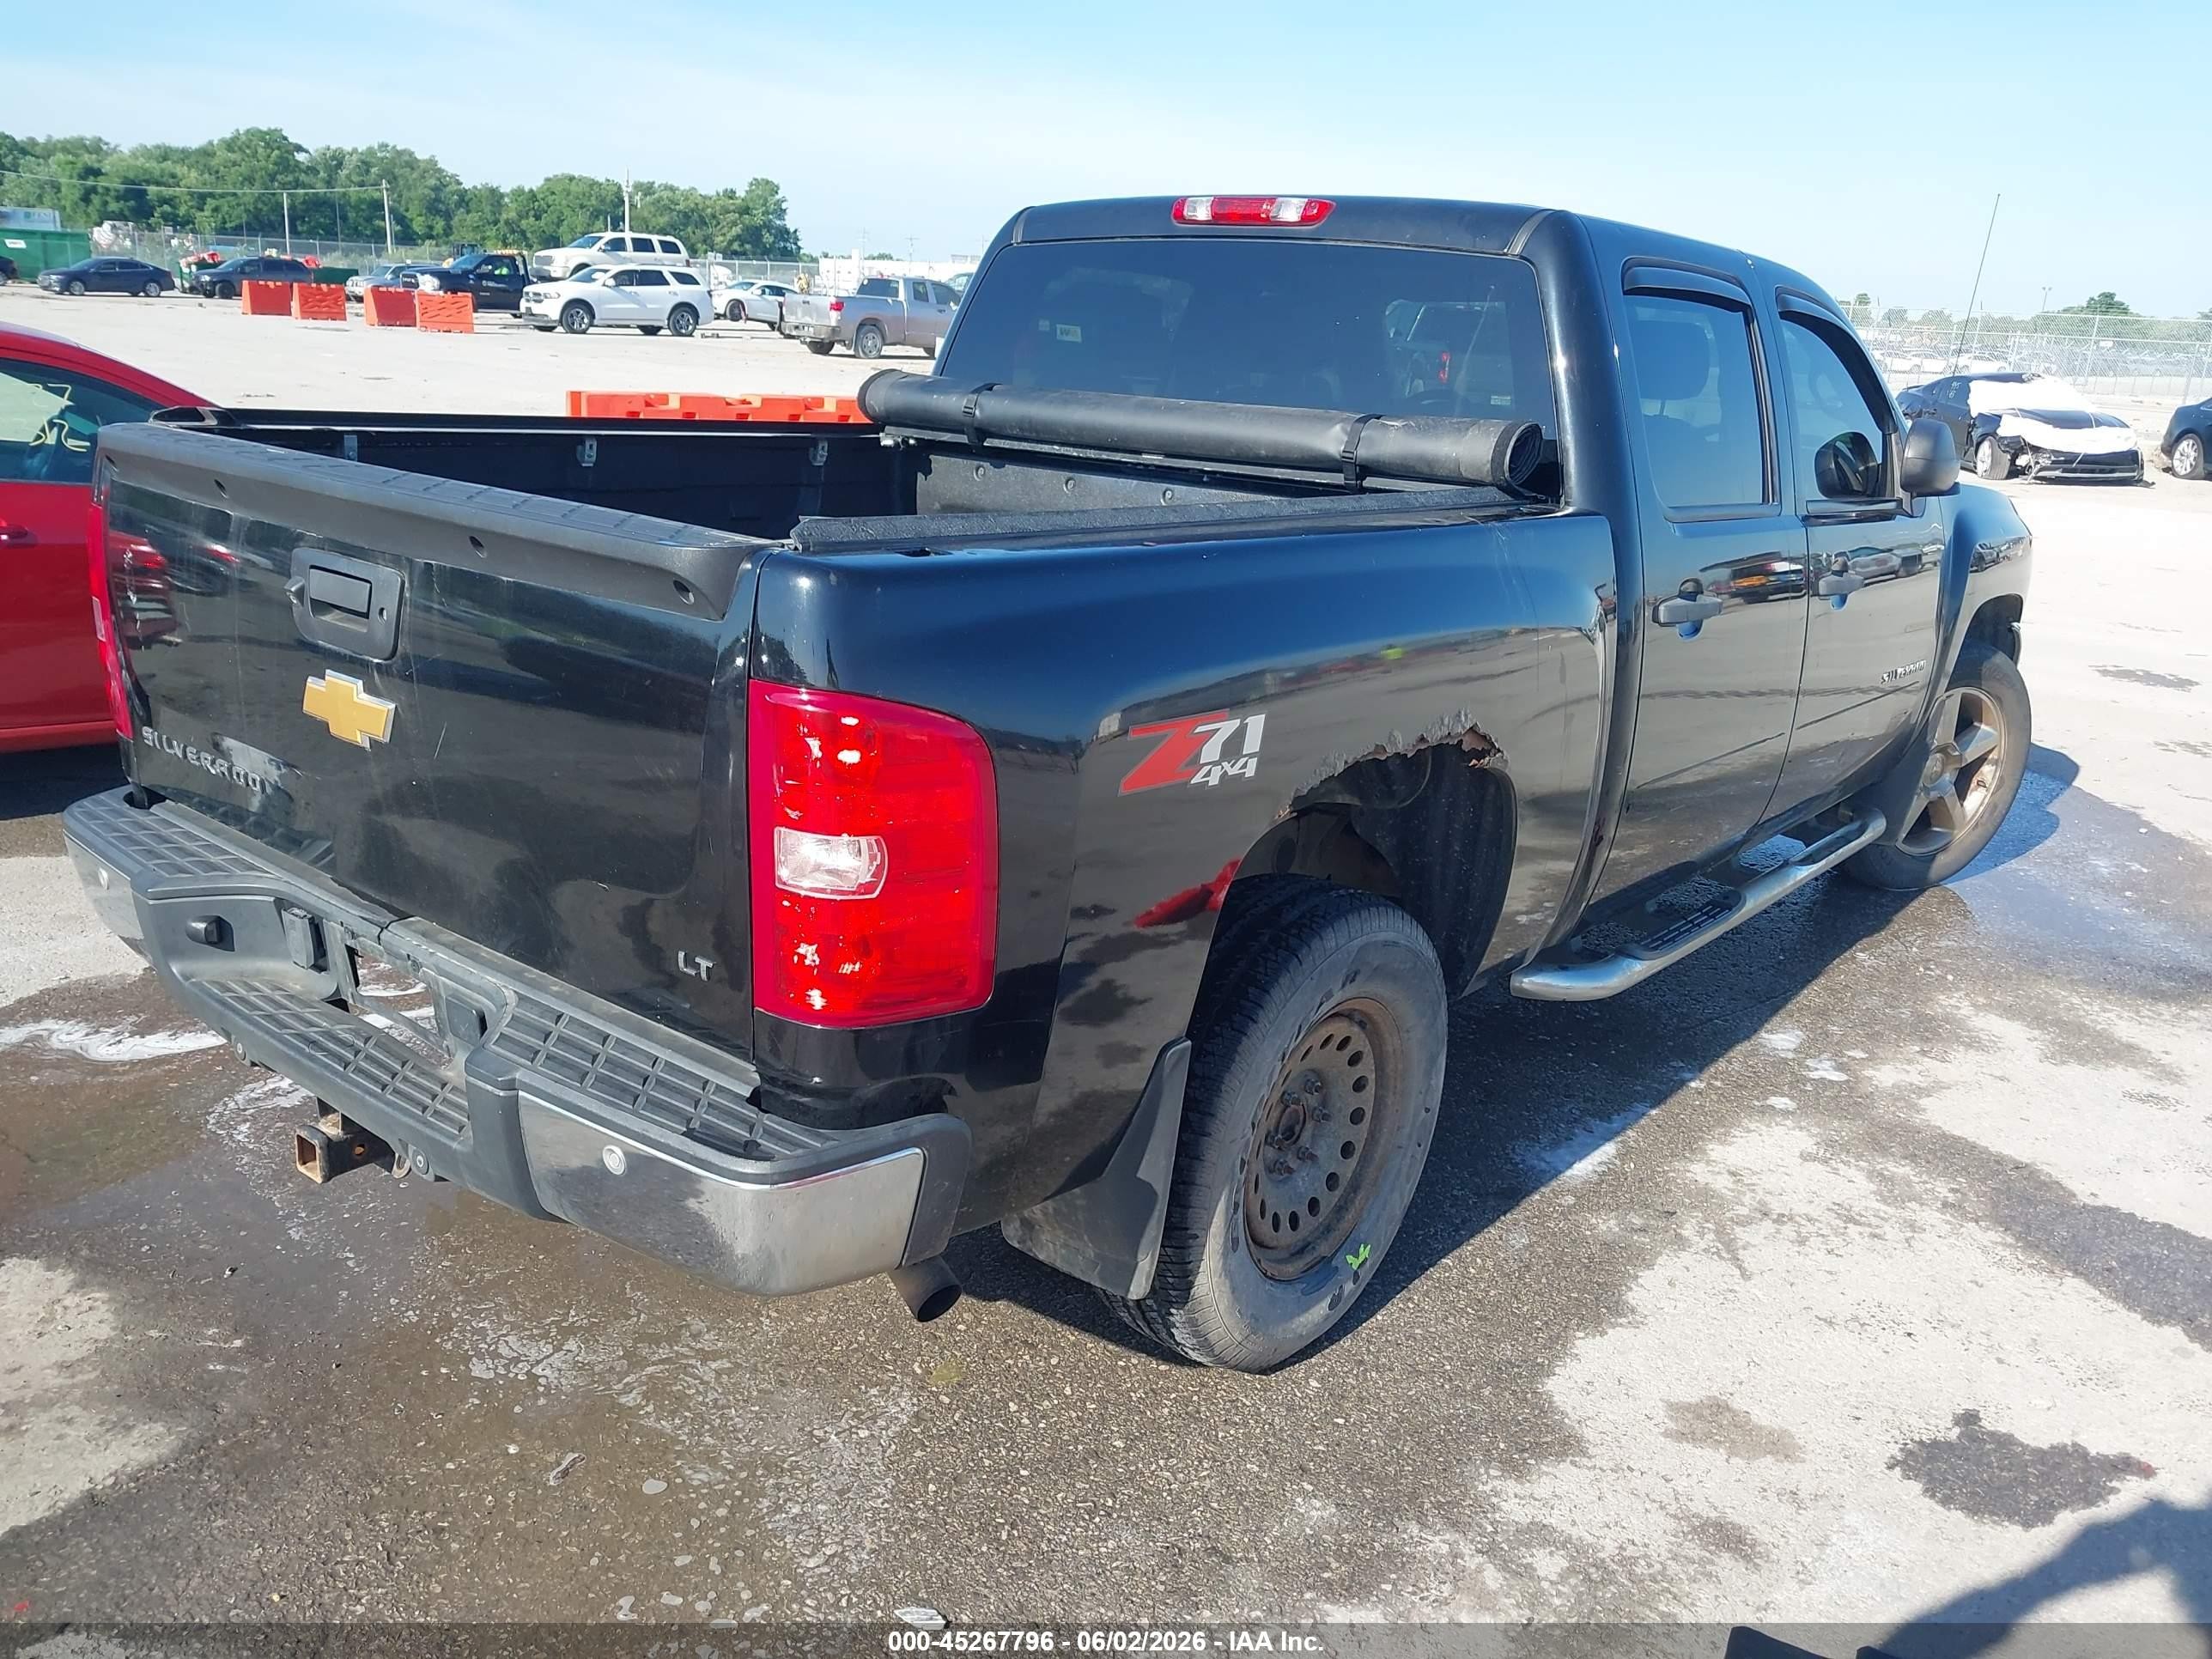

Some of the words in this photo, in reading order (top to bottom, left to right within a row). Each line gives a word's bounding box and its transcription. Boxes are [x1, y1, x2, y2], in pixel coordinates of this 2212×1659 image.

[142, 725, 262, 792] SILVERADO
[1119, 709, 1266, 796] Z71
[678, 951, 714, 981] LT
